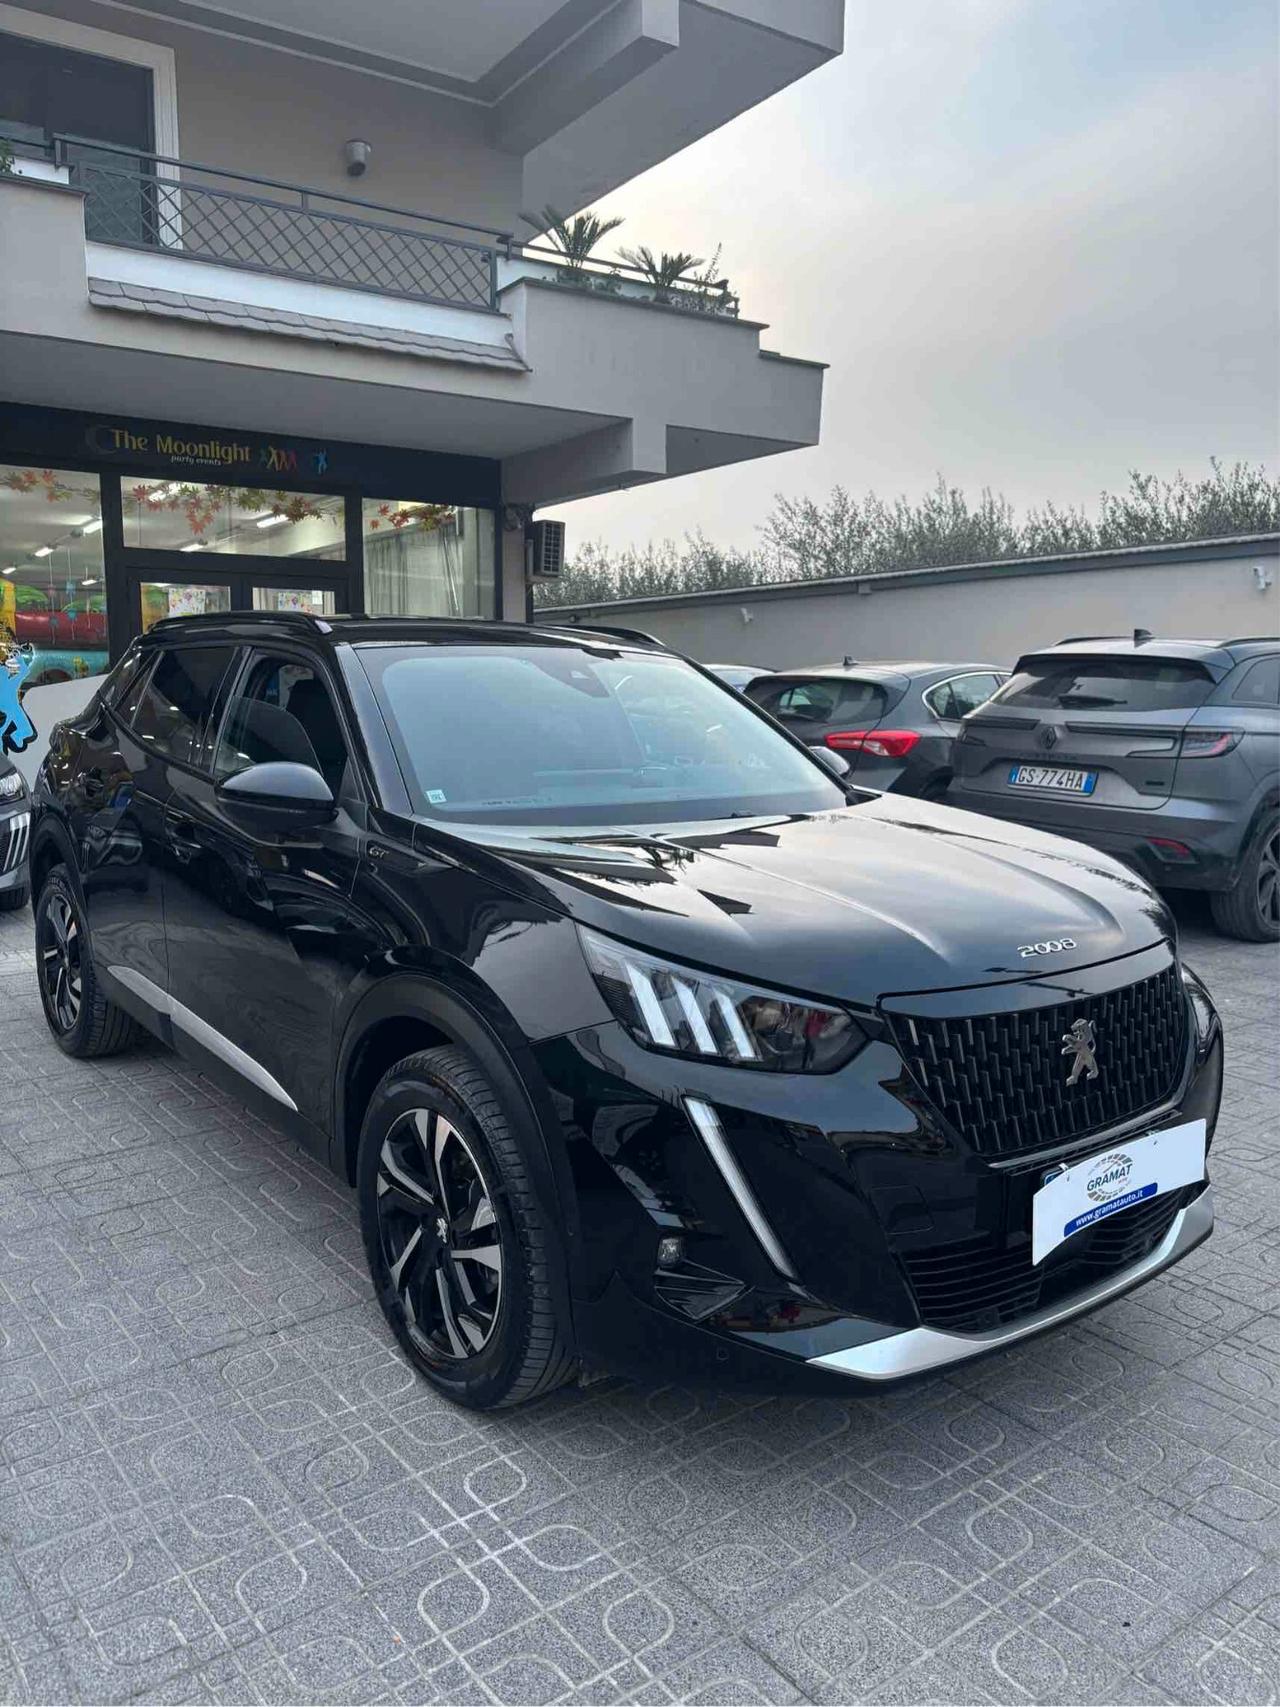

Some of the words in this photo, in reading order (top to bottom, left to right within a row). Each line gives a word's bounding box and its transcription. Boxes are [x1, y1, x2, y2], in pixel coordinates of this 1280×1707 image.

[112, 429, 148, 450] The
[156, 434, 250, 464] Moonlight
[171, 455, 194, 465] party
[196, 458, 221, 466] events
[369, 846, 389, 858] GT
[1017, 938, 1076, 958] 2008
[1087, 1163, 1133, 1191] GRAMAT
[1075, 1190, 1143, 1226] www.gramatauto.it
